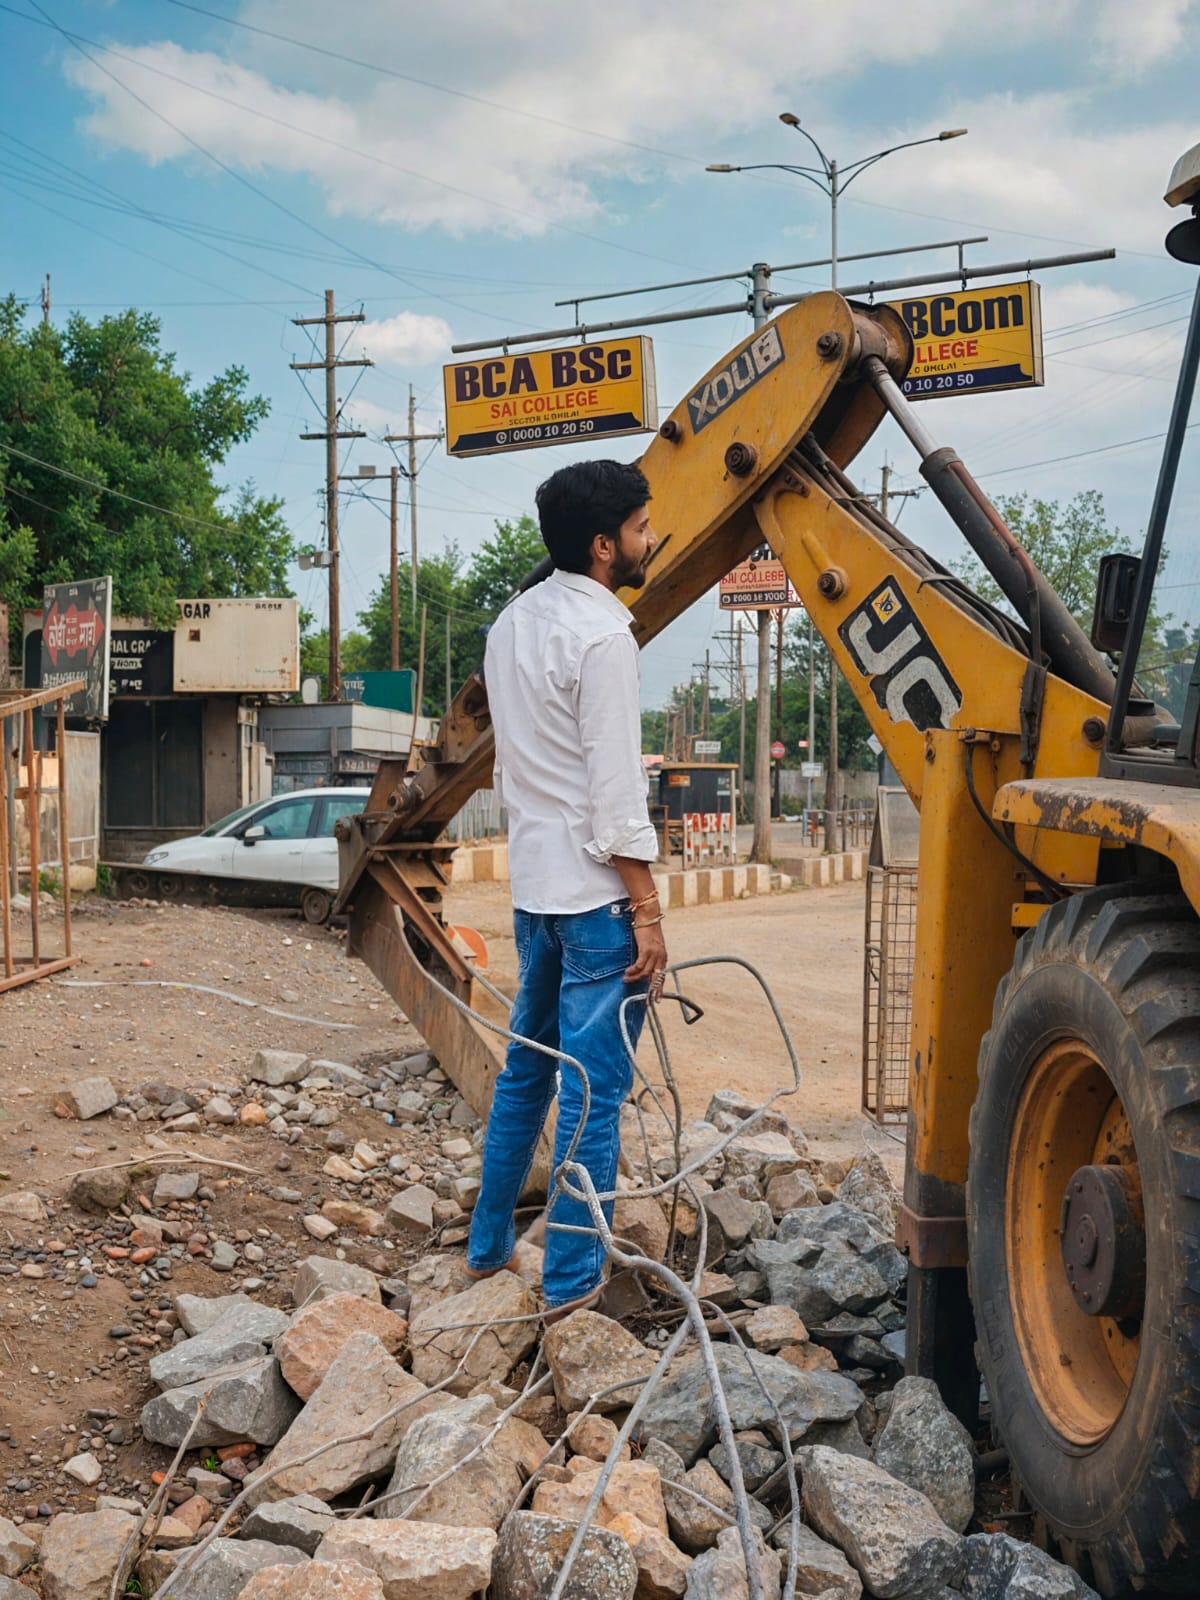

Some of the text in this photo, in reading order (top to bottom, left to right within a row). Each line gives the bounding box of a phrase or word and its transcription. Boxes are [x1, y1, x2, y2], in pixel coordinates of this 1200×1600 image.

[902, 294, 1024, 340] BCom
[916, 339, 978, 364] LLEGE
[454, 346, 632, 403] BCA BSc
[915, 379, 933, 391] 10
[936, 376, 953, 389] 20
[957, 373, 974, 386] 50
[490, 389, 599, 420] SAI COLLEGE
[513, 420, 594, 441] 0000 10 20 50
[110, 640, 129, 654] IAL
[848, 610, 961, 729] JC
